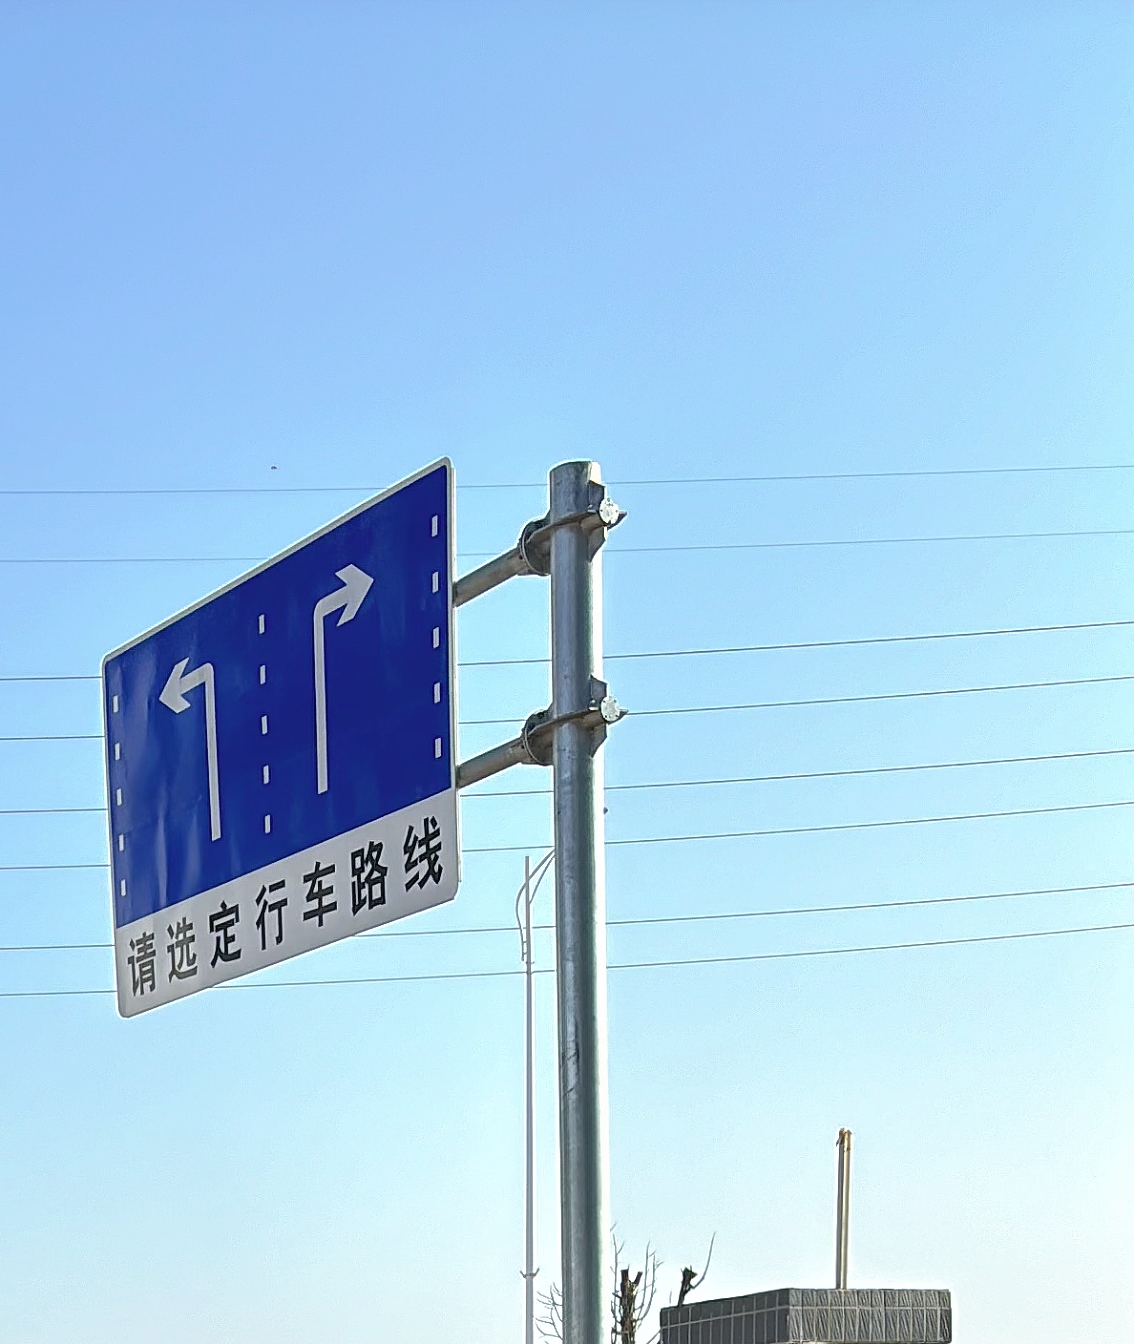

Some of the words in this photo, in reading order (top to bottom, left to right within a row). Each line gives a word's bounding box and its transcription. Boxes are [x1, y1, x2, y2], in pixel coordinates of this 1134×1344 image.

[127, 815, 444, 997] 请选定行车路线
